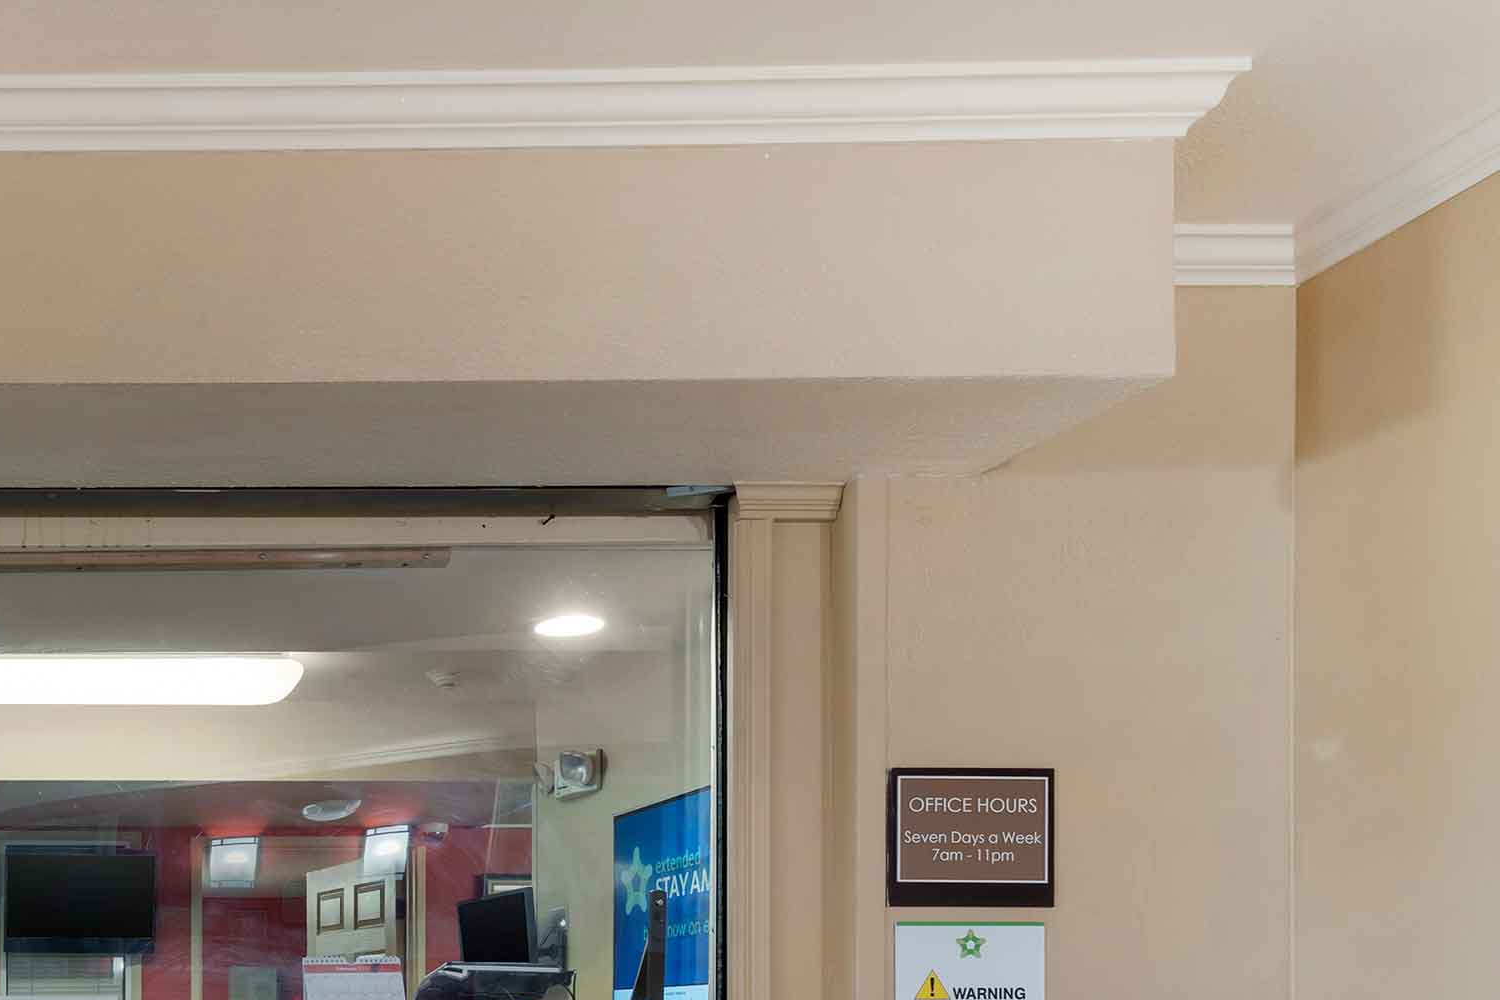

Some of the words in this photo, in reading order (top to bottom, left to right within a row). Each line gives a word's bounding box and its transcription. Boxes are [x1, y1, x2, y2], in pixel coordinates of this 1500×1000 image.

[909, 797, 973, 814] OFFICE
[977, 797, 1038, 814] HOURS
[904, 830, 947, 844] Seven
[951, 831, 985, 846] Days
[988, 835, 998, 844] a
[1002, 832, 1043, 845] Week
[656, 847, 700, 874] extended
[932, 848, 963, 862] 7am
[978, 849, 1014, 864] 11pm
[656, 872, 689, 899] STAY
[952, 987, 1026, 1000] WARNING
